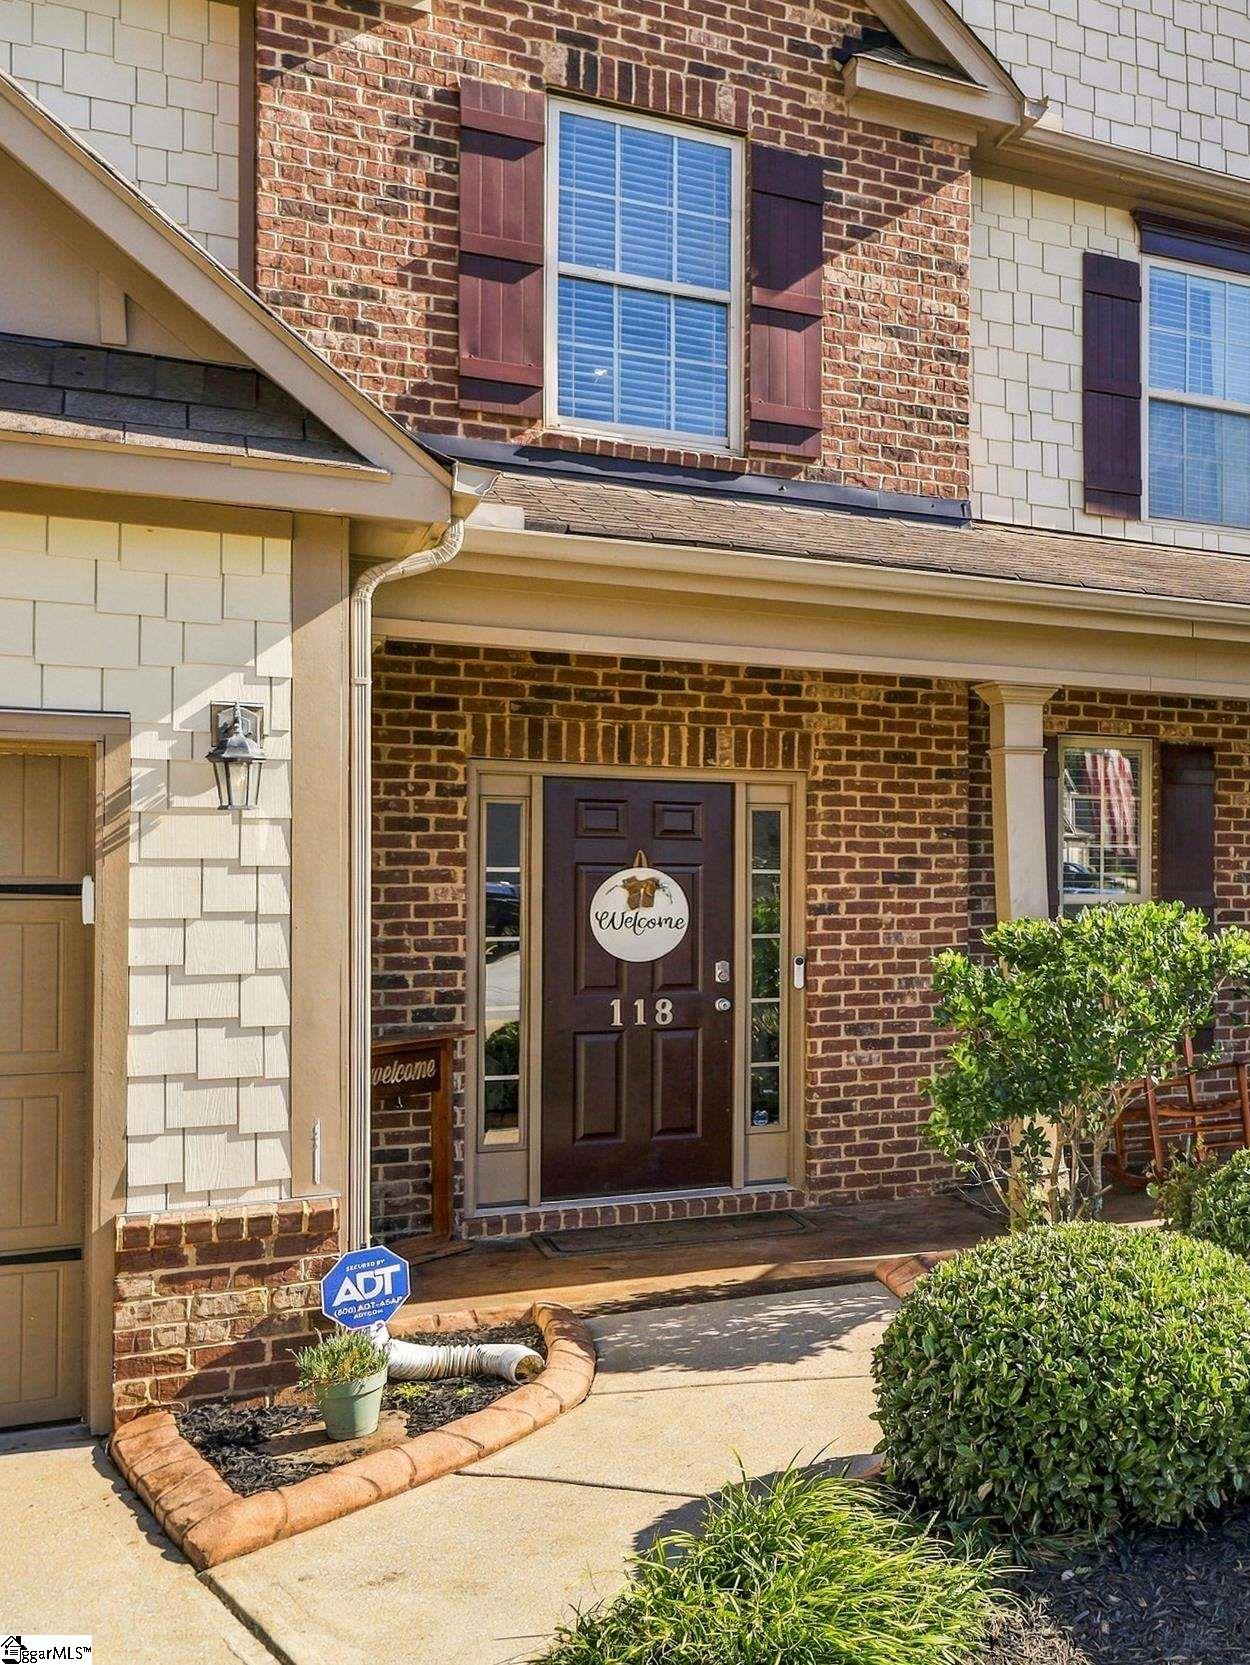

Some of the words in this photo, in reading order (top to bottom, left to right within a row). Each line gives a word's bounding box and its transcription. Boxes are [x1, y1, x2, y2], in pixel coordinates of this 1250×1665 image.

[595, 911, 685, 935] Welcome
[610, 998, 674, 1026] 118
[345, 1261, 375, 1271] SECURED
[332, 1264, 400, 1307] ADT
[334, 1306, 357, 1318] (800)
